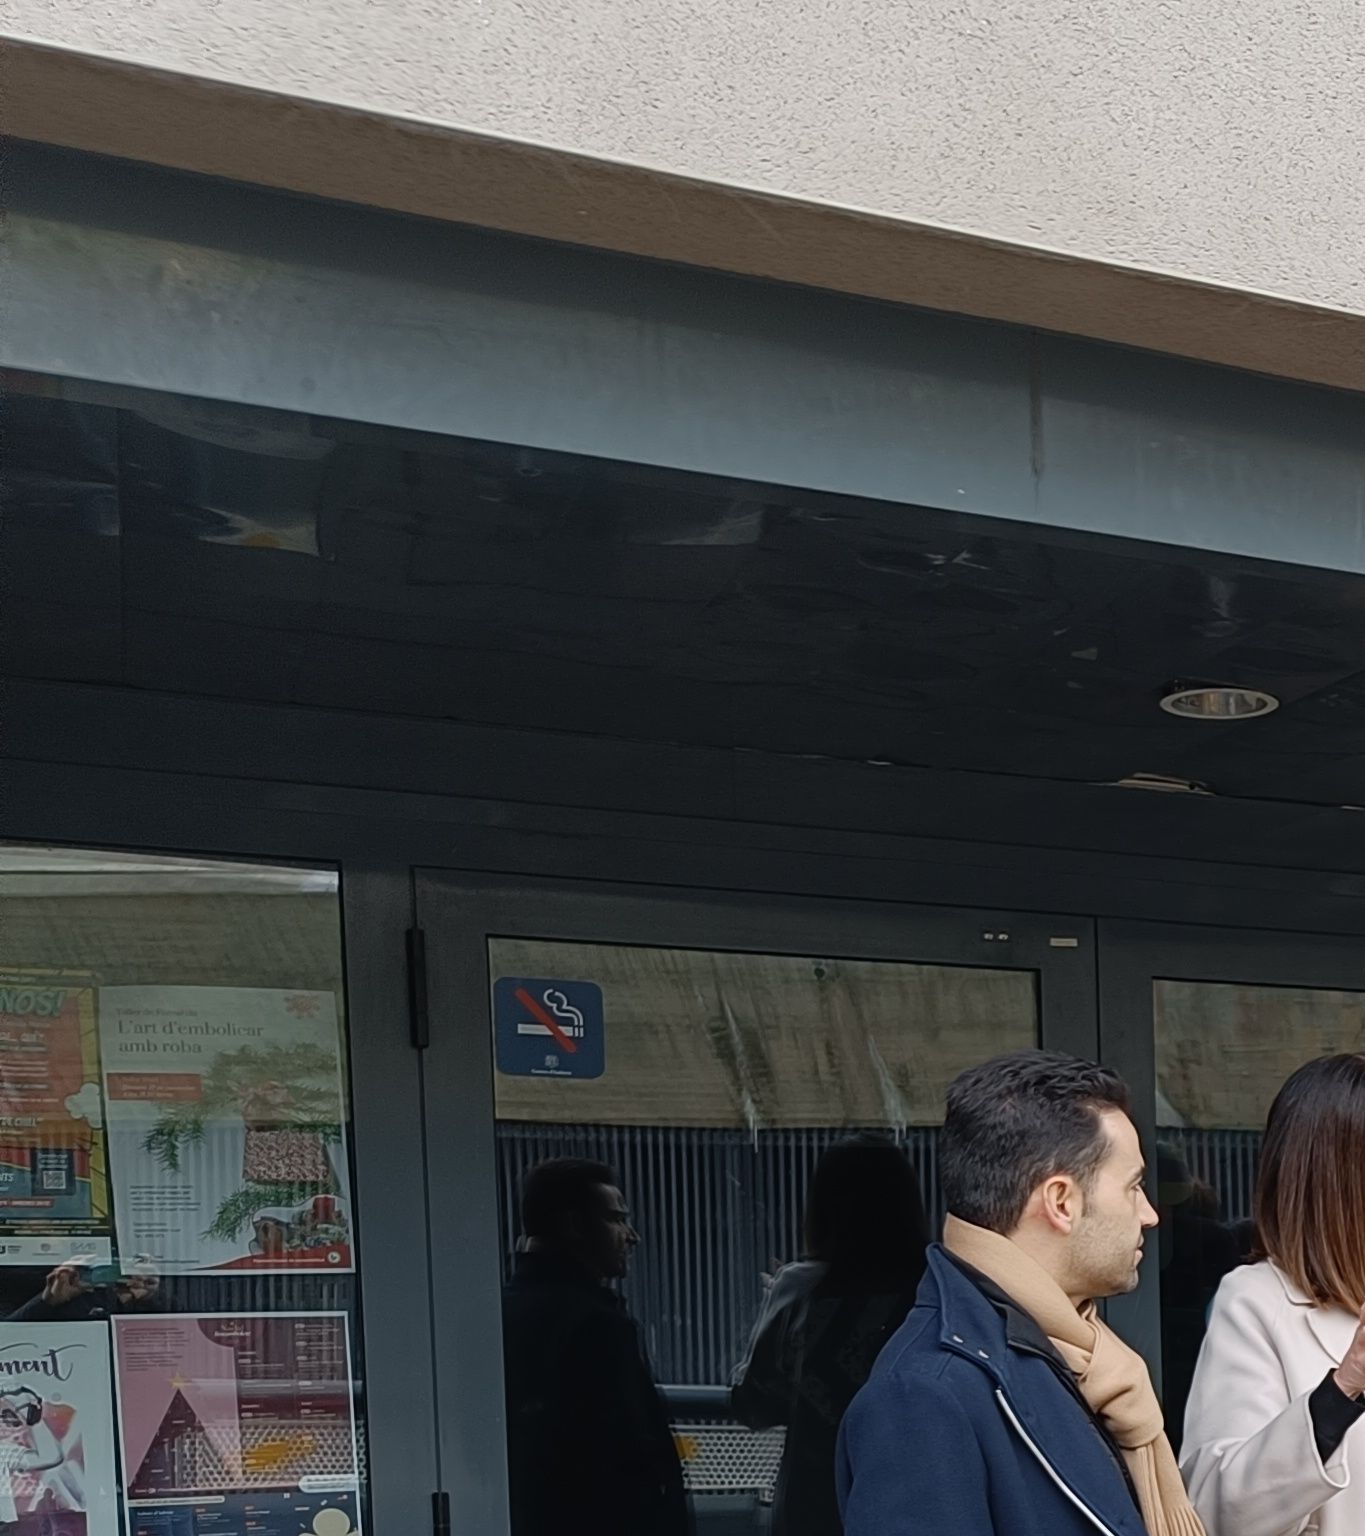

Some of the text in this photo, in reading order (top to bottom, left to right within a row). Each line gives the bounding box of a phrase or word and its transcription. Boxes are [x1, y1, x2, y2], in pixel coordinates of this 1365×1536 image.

[118, 1020, 265, 1037] L'art d'embolicar
[119, 1039, 203, 1054] amb roba
